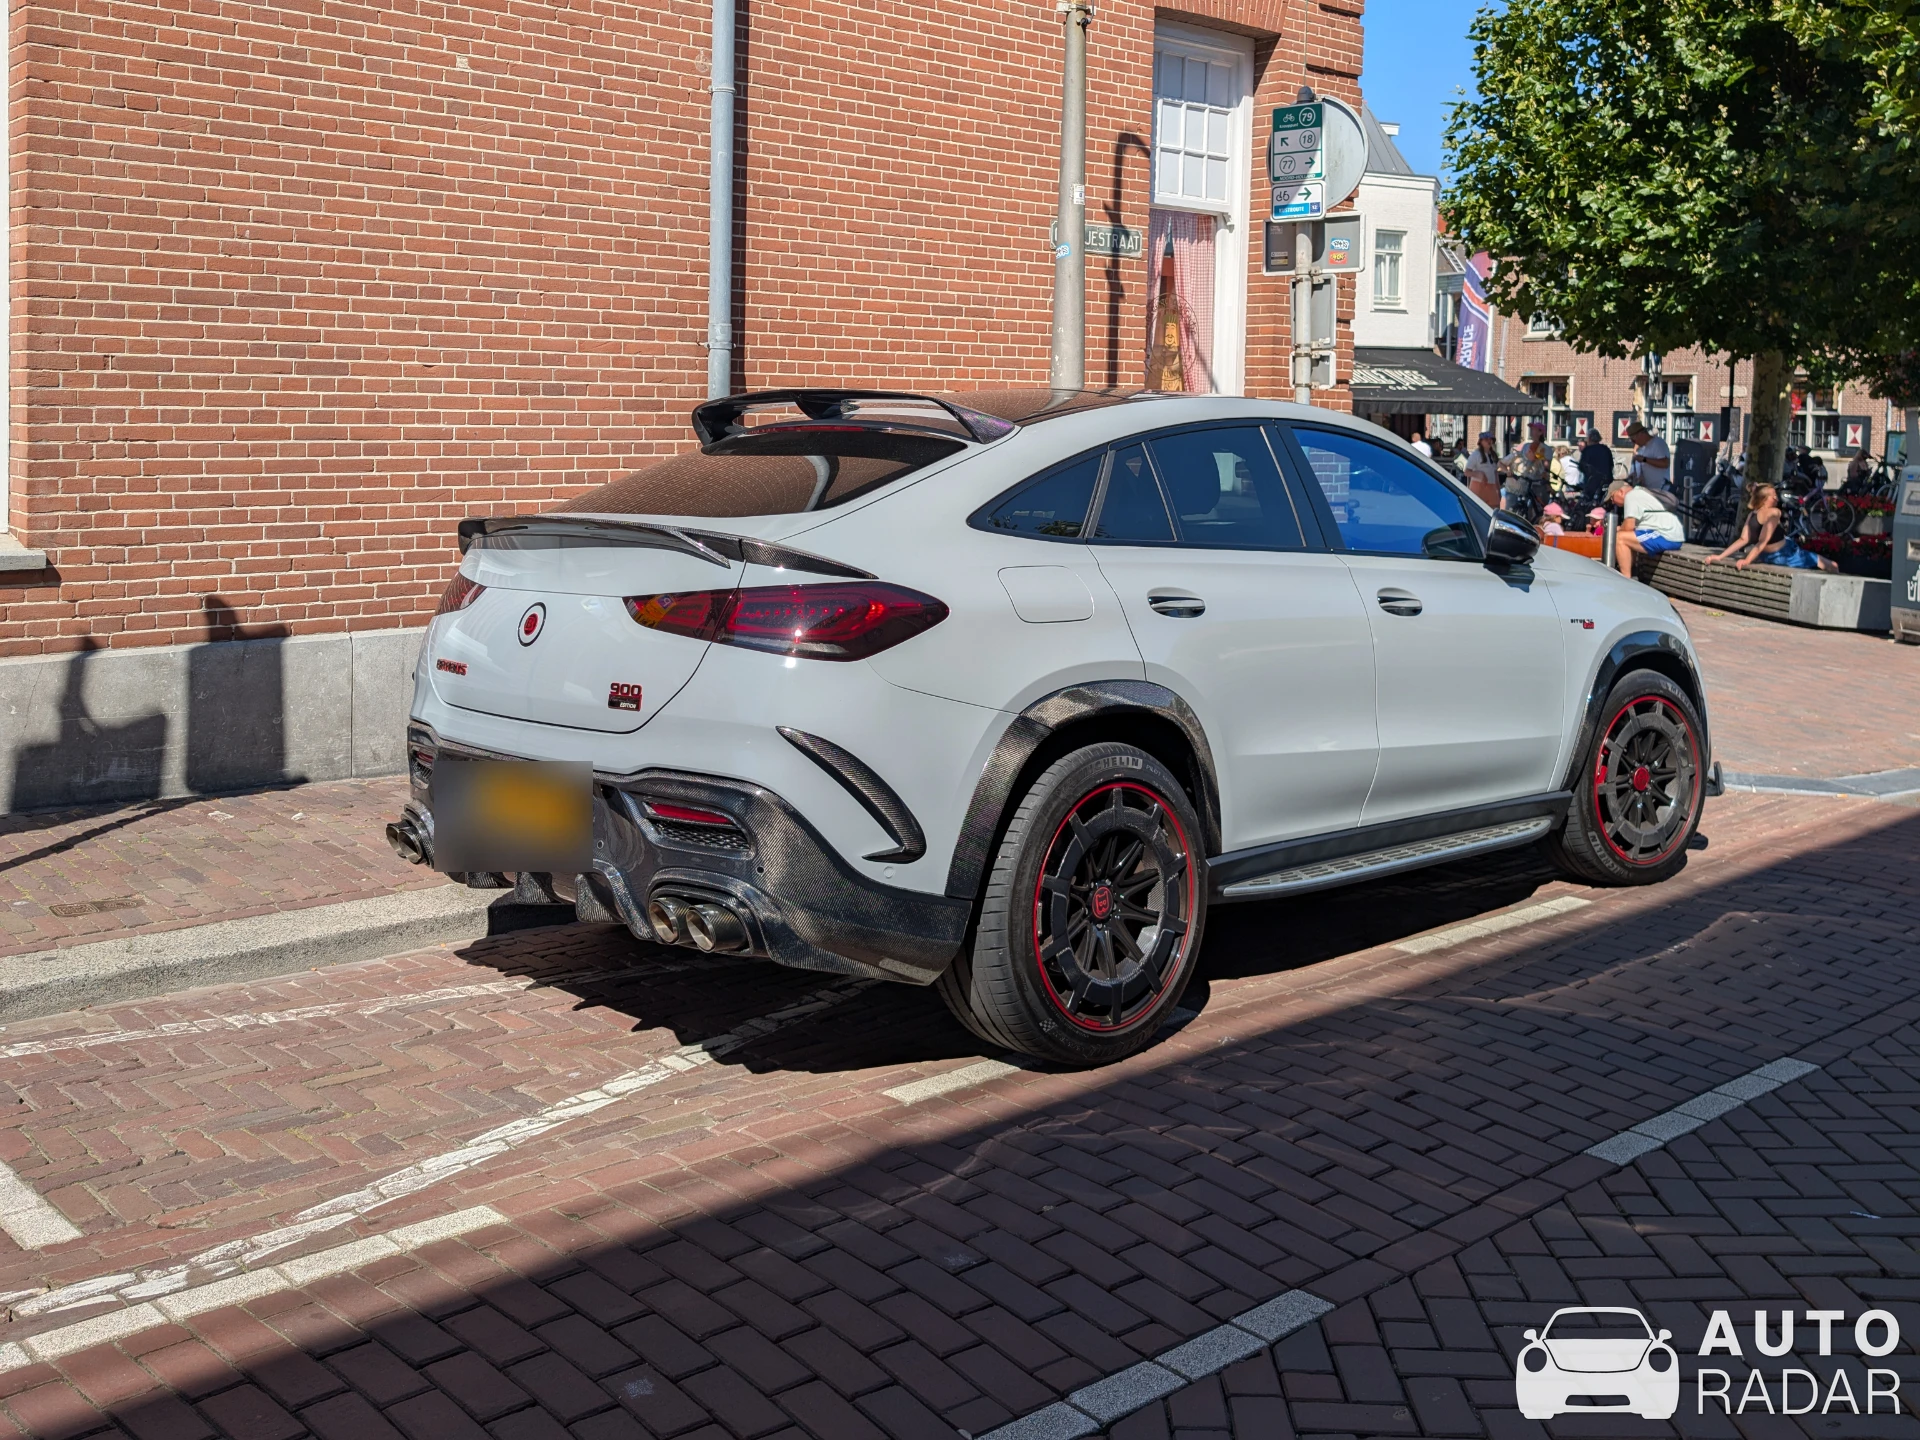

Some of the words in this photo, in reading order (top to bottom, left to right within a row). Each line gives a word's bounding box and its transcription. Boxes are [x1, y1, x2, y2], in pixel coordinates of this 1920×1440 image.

[1302, 112, 1313, 122] 79
[1302, 134, 1313, 145] 18
[1282, 159, 1293, 170] 77
[436, 658, 468, 676] BRABUS
[610, 682, 642, 698] 900
[1082, 756, 1140, 776] MICHELIN
